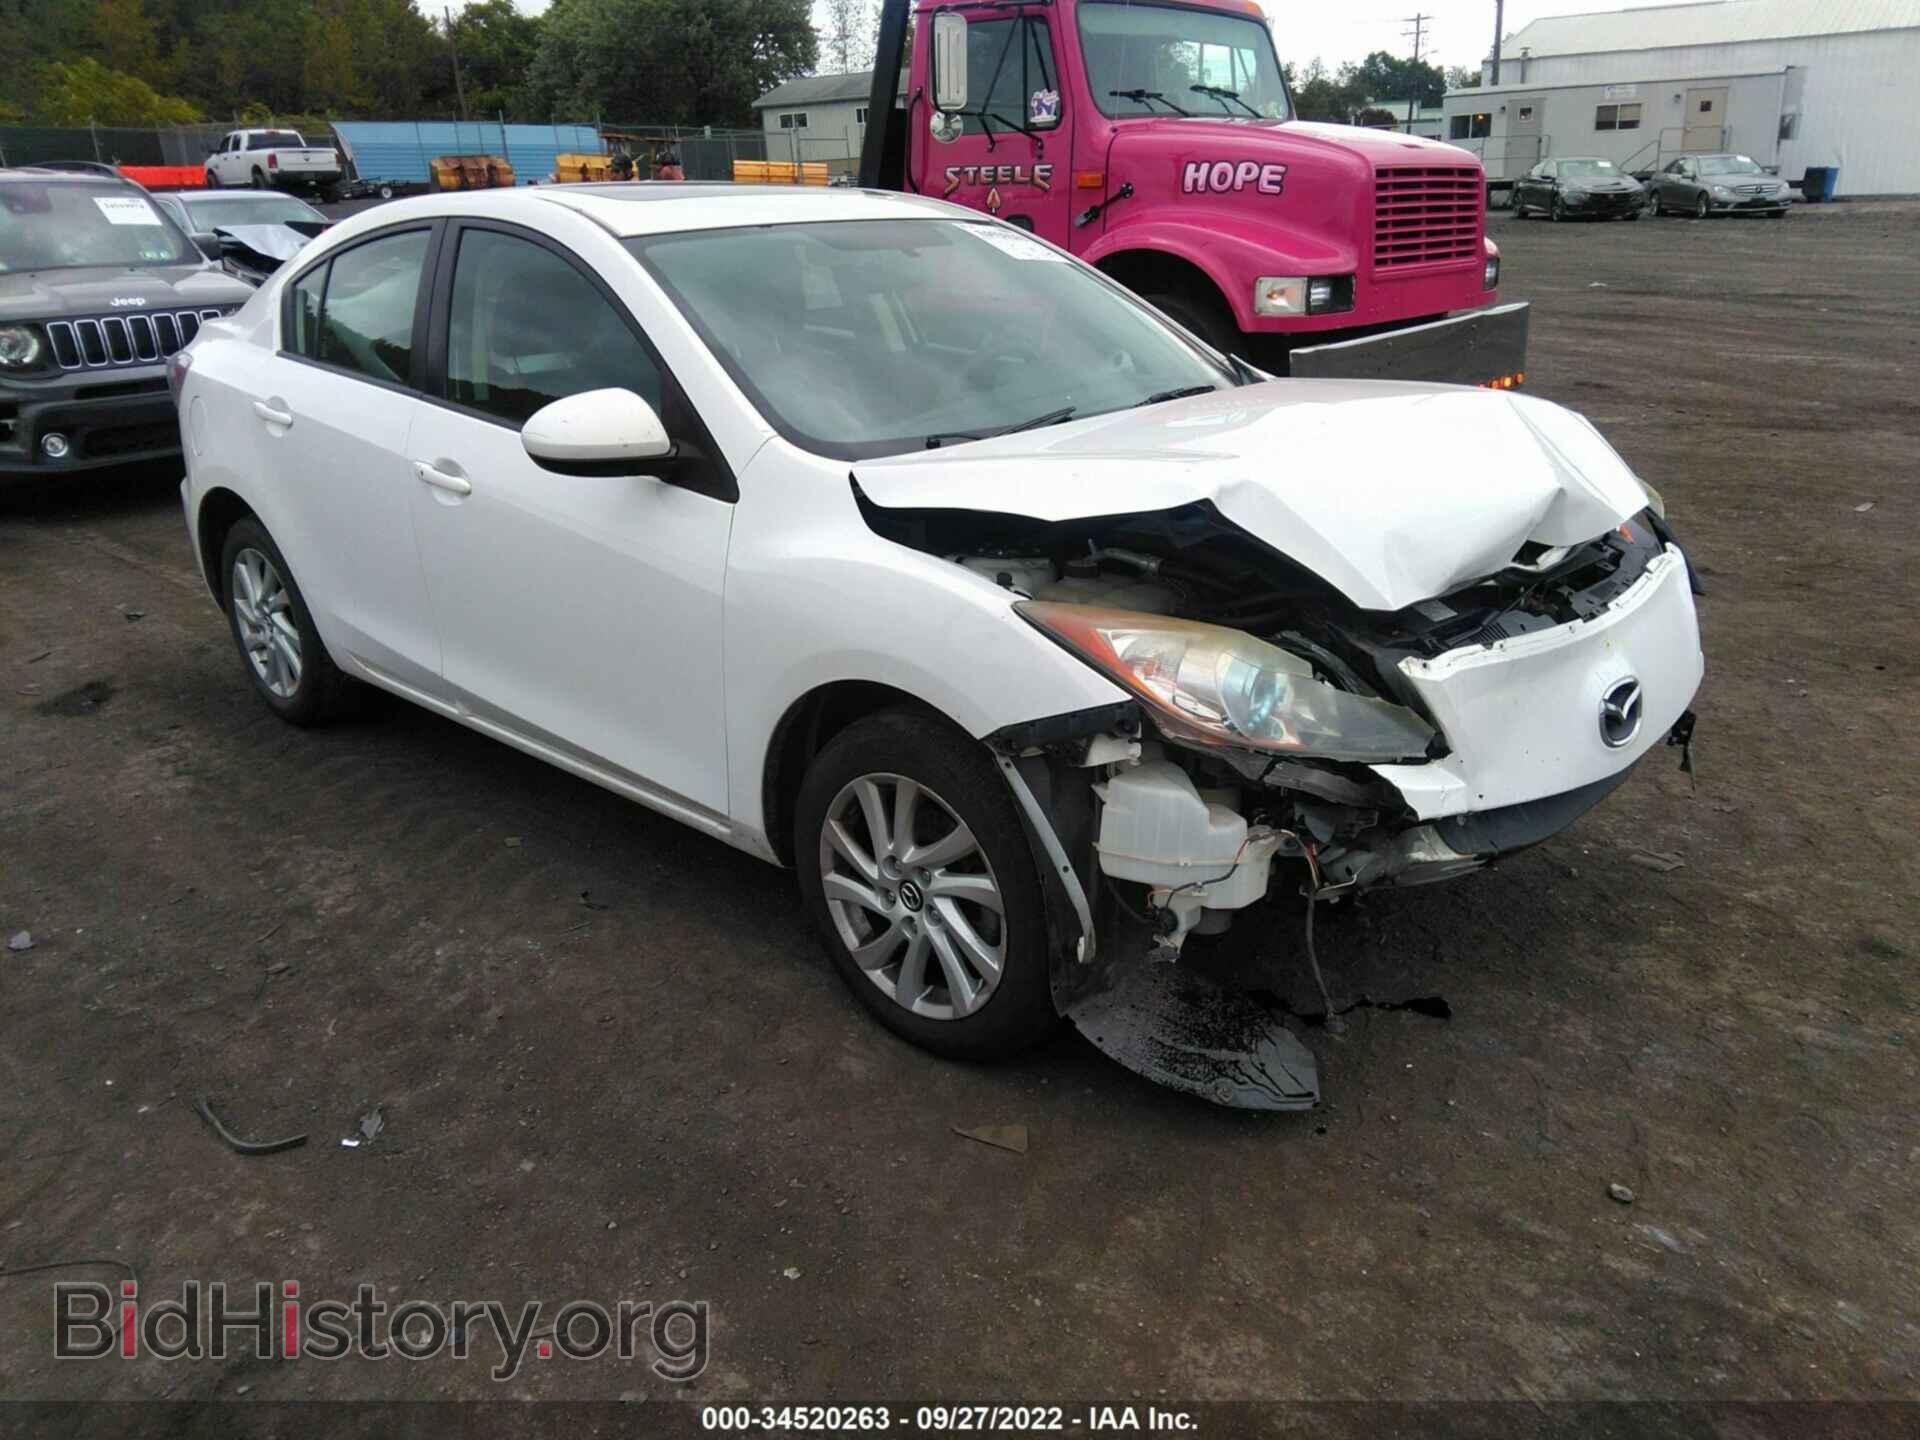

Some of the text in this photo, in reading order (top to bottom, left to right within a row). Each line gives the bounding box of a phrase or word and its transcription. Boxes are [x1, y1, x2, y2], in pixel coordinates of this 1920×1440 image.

[944, 163, 1053, 197] STEELE
[1183, 160, 1287, 195] HOPE
[110, 297, 146, 307] Jeep
